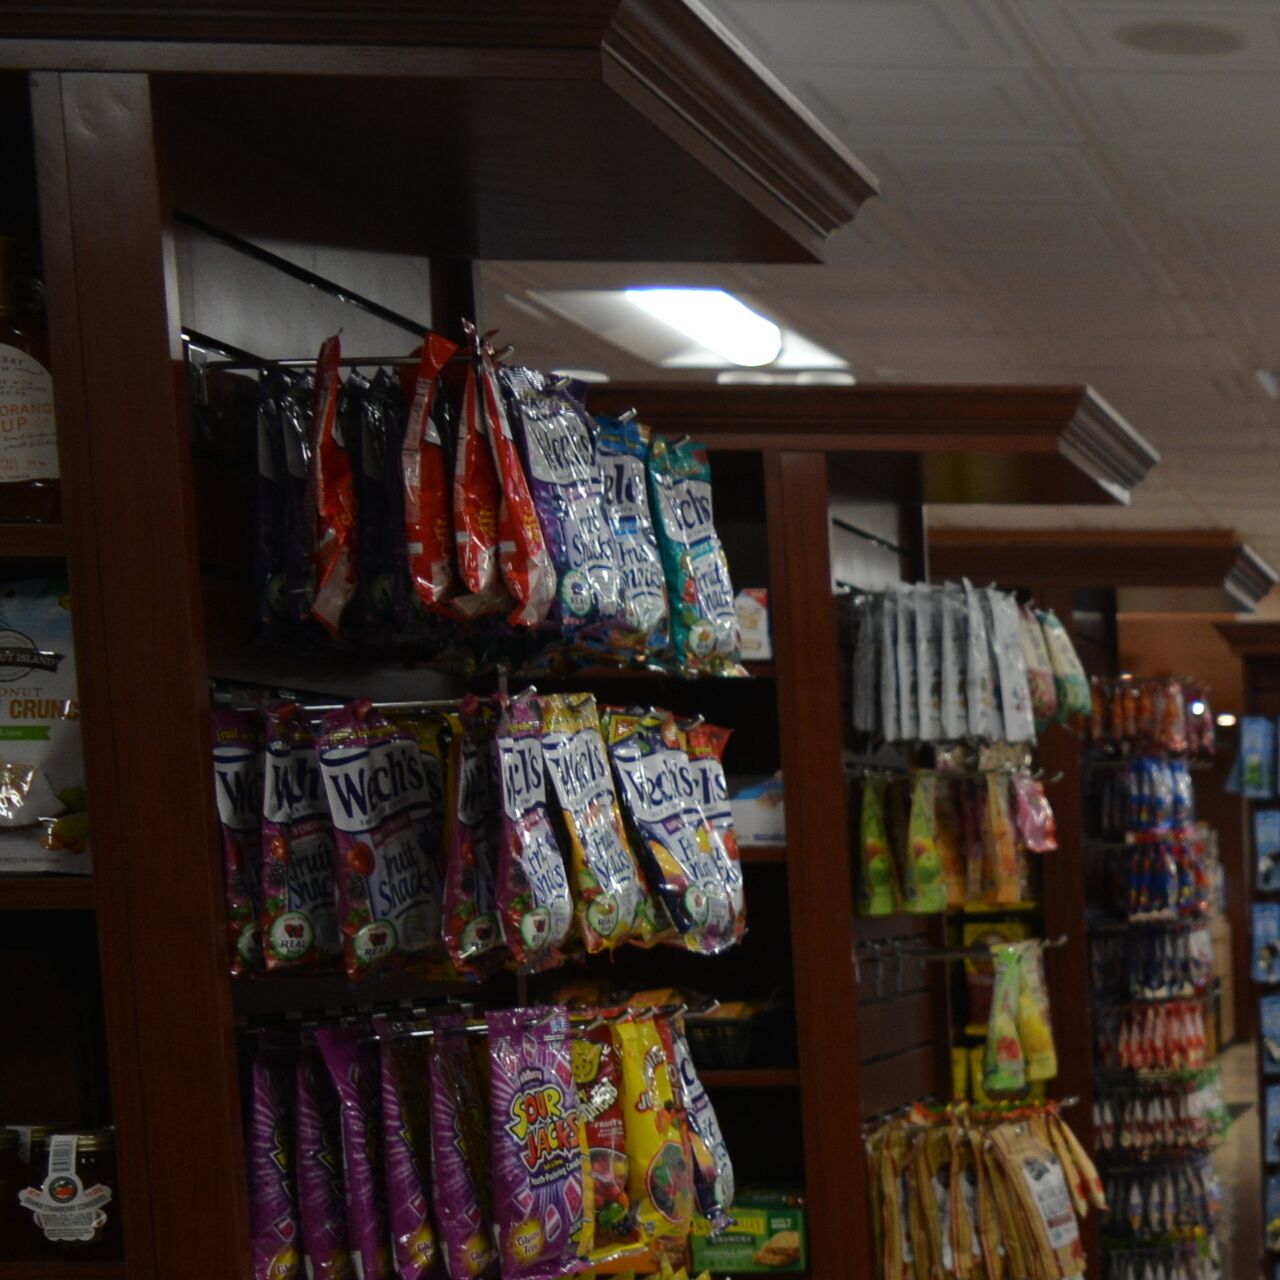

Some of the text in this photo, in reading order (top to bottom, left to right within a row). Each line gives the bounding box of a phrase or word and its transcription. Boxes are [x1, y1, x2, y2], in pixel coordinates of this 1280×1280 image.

[0, 687, 43, 698] ONUT
[10, 698, 81, 720] CRUNC
[510, 1087, 563, 1141] SOUR
[523, 1113, 580, 1170] JACKS
